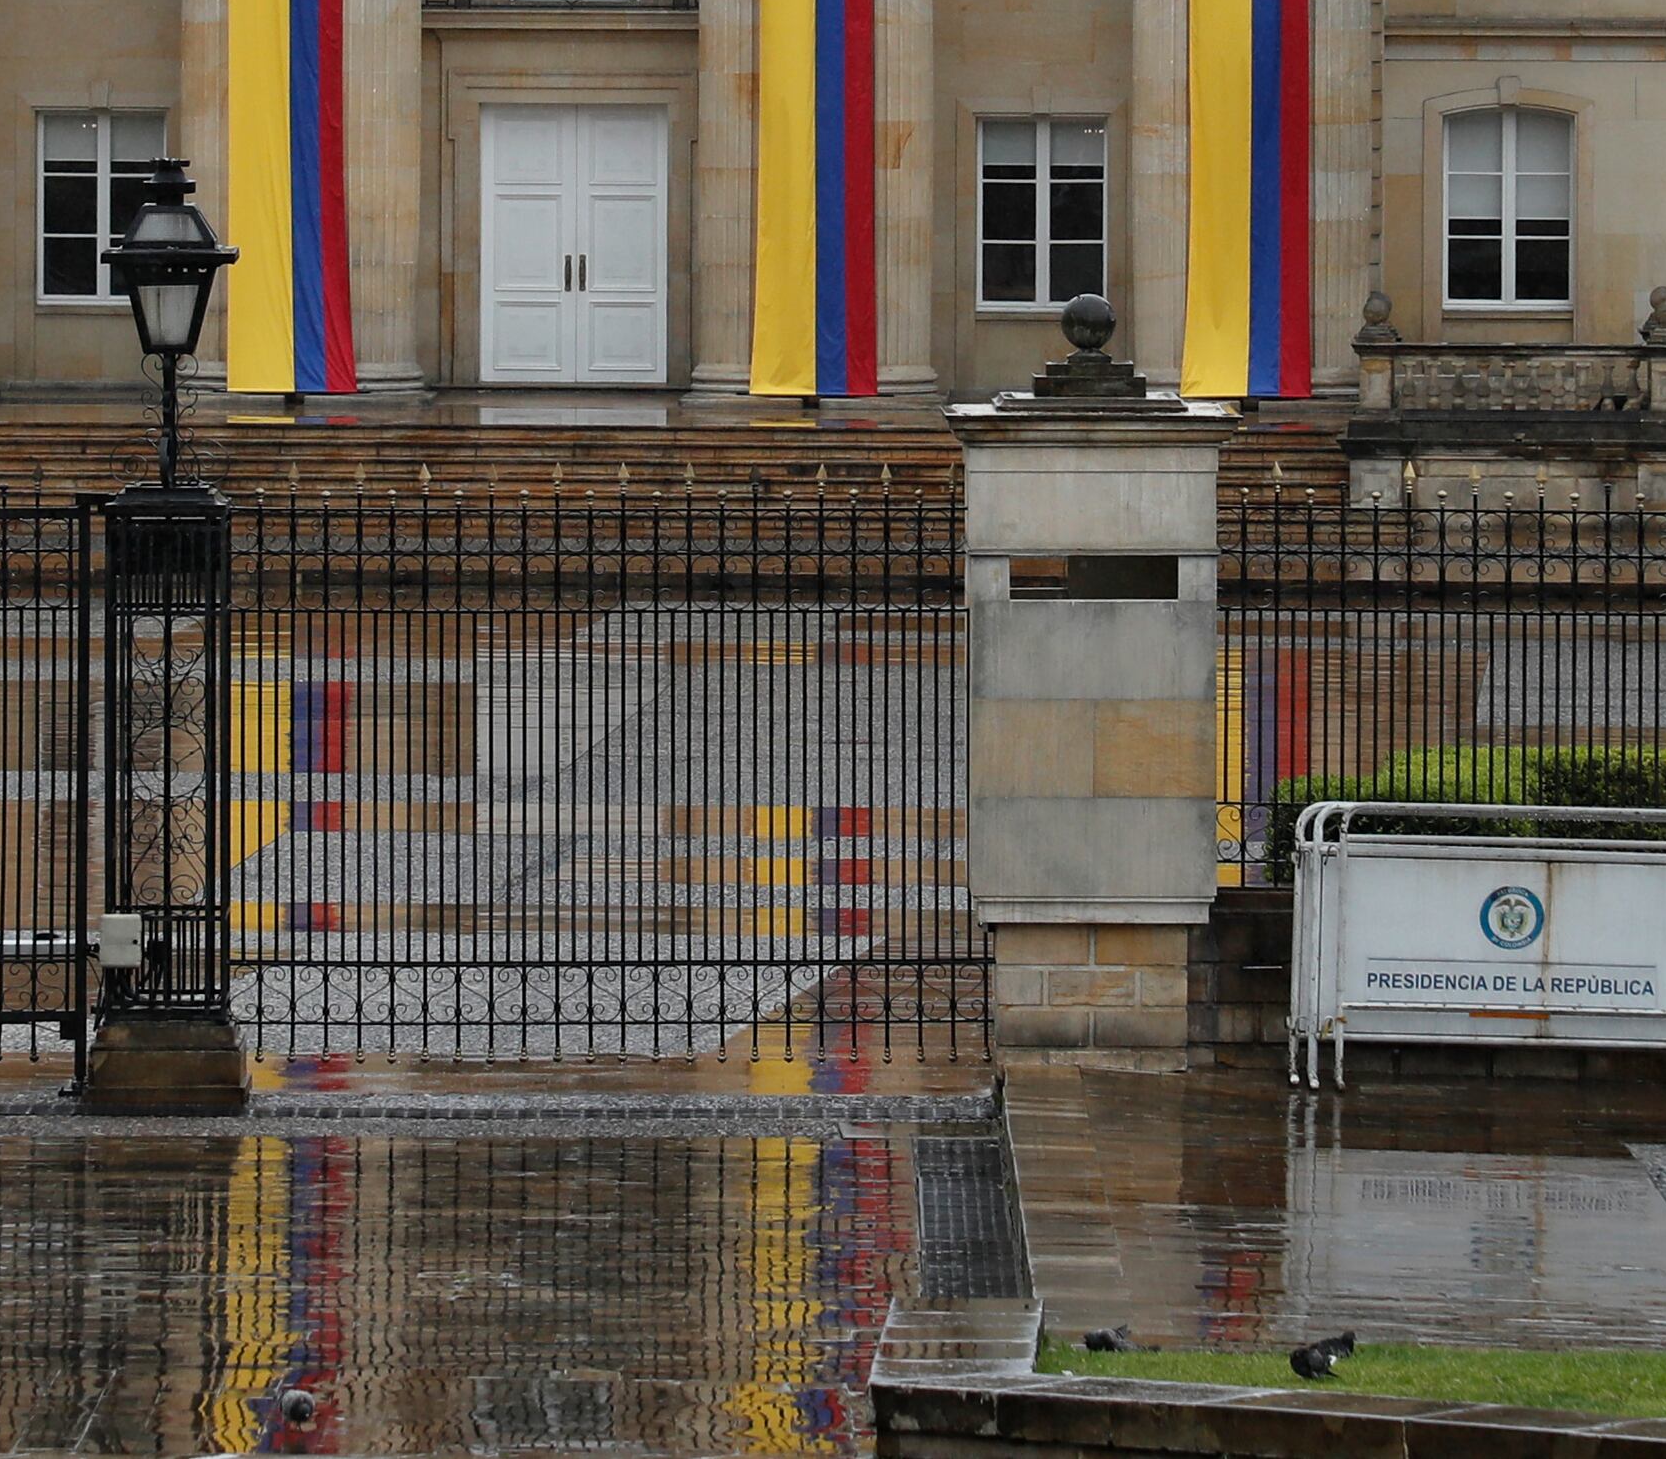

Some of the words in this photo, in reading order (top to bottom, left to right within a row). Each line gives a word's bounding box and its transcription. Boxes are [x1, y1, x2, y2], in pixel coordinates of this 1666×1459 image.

[1367, 972, 1488, 991] PRESIDENCIA
[1493, 975, 1517, 992] DE
[1522, 976, 1546, 993] LA
[1550, 974, 1655, 996] REPÚBLICA
